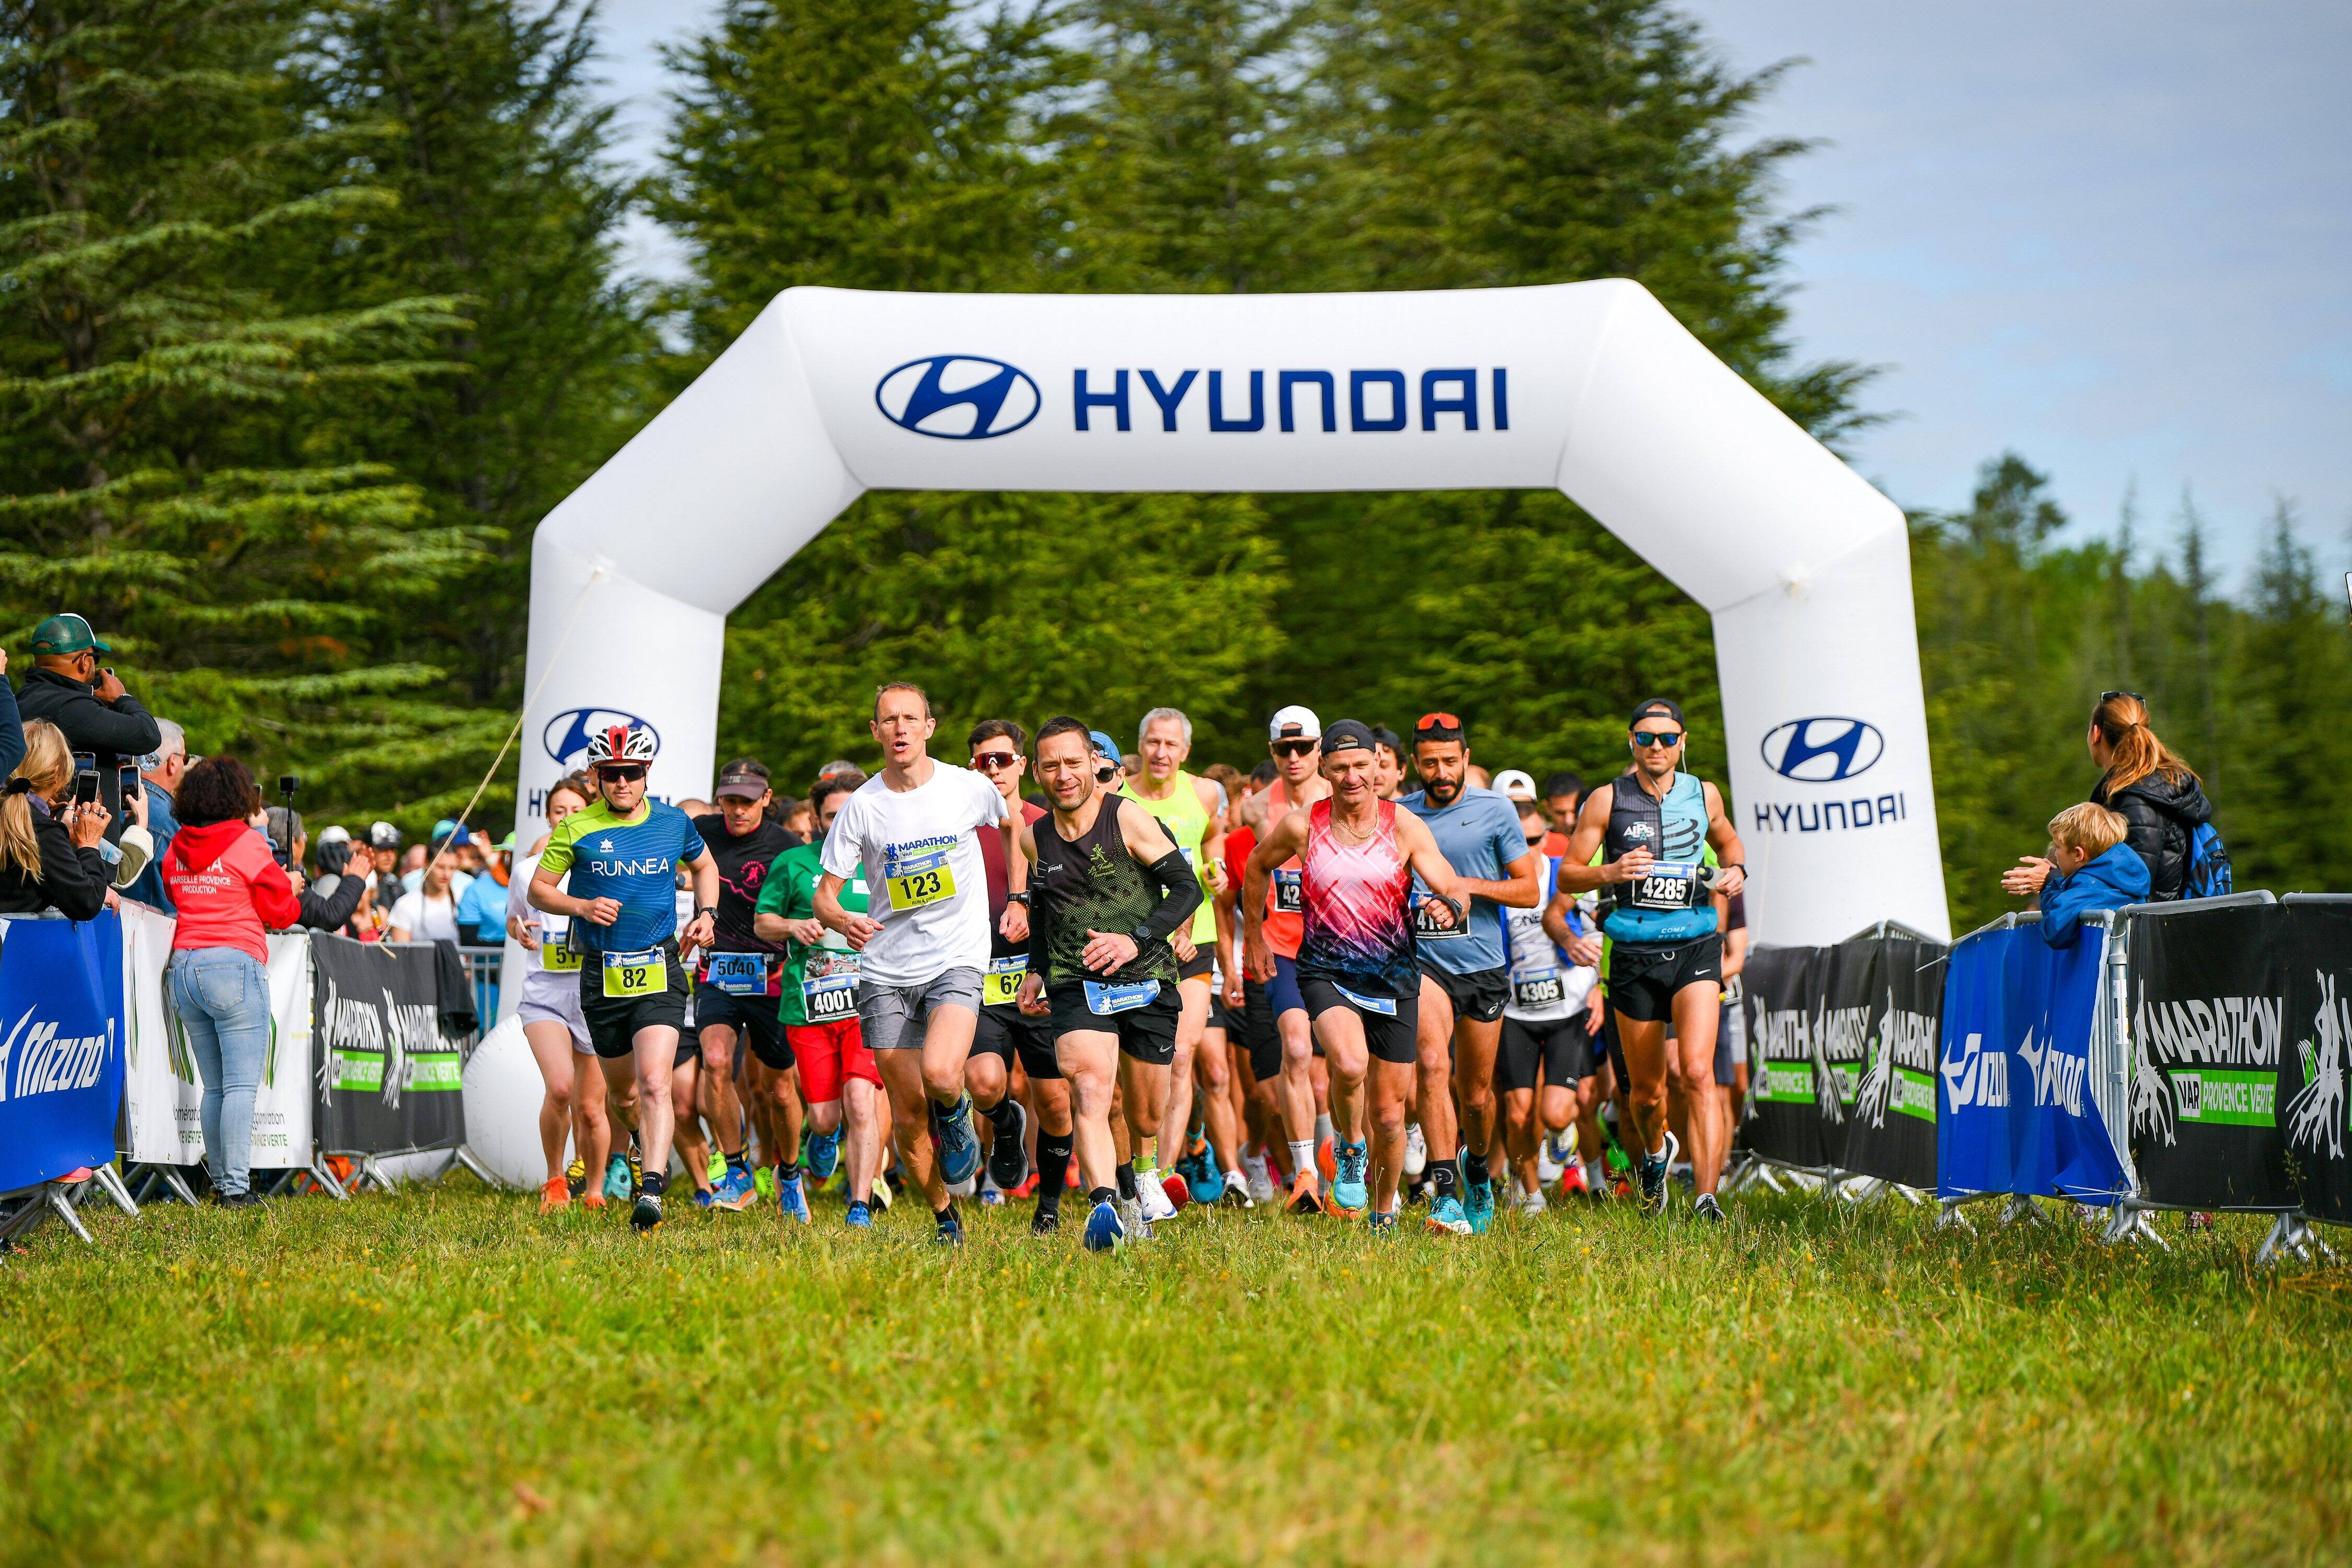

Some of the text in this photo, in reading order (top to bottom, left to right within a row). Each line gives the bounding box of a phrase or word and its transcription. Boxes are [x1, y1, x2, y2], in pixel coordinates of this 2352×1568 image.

[1074, 367, 1509, 433] HYUNDAI
[1754, 790, 1906, 832] HYUNDAI
[898, 835, 958, 852] MARATHON
[591, 857, 669, 877] RUNNEA
[903, 858, 932, 870] MARATHON
[170, 875, 230, 886] MARSEILLE PROVENCE
[182, 885, 217, 894] PRODUCTION
[900, 872, 941, 900] 123
[1642, 877, 1687, 901] 4285
[622, 968, 648, 988] 82
[717, 961, 755, 976] 5040
[814, 988, 854, 1013] 4001
[1112, 994, 1143, 1004] MARATHON
[1519, 979, 1560, 1002] 4305
[2147, 996, 2282, 1066] MARATHON
[2176, 1080, 2275, 1114] VAR PROVENCE VERTE
[266, 1134, 288, 1146] VERTE
